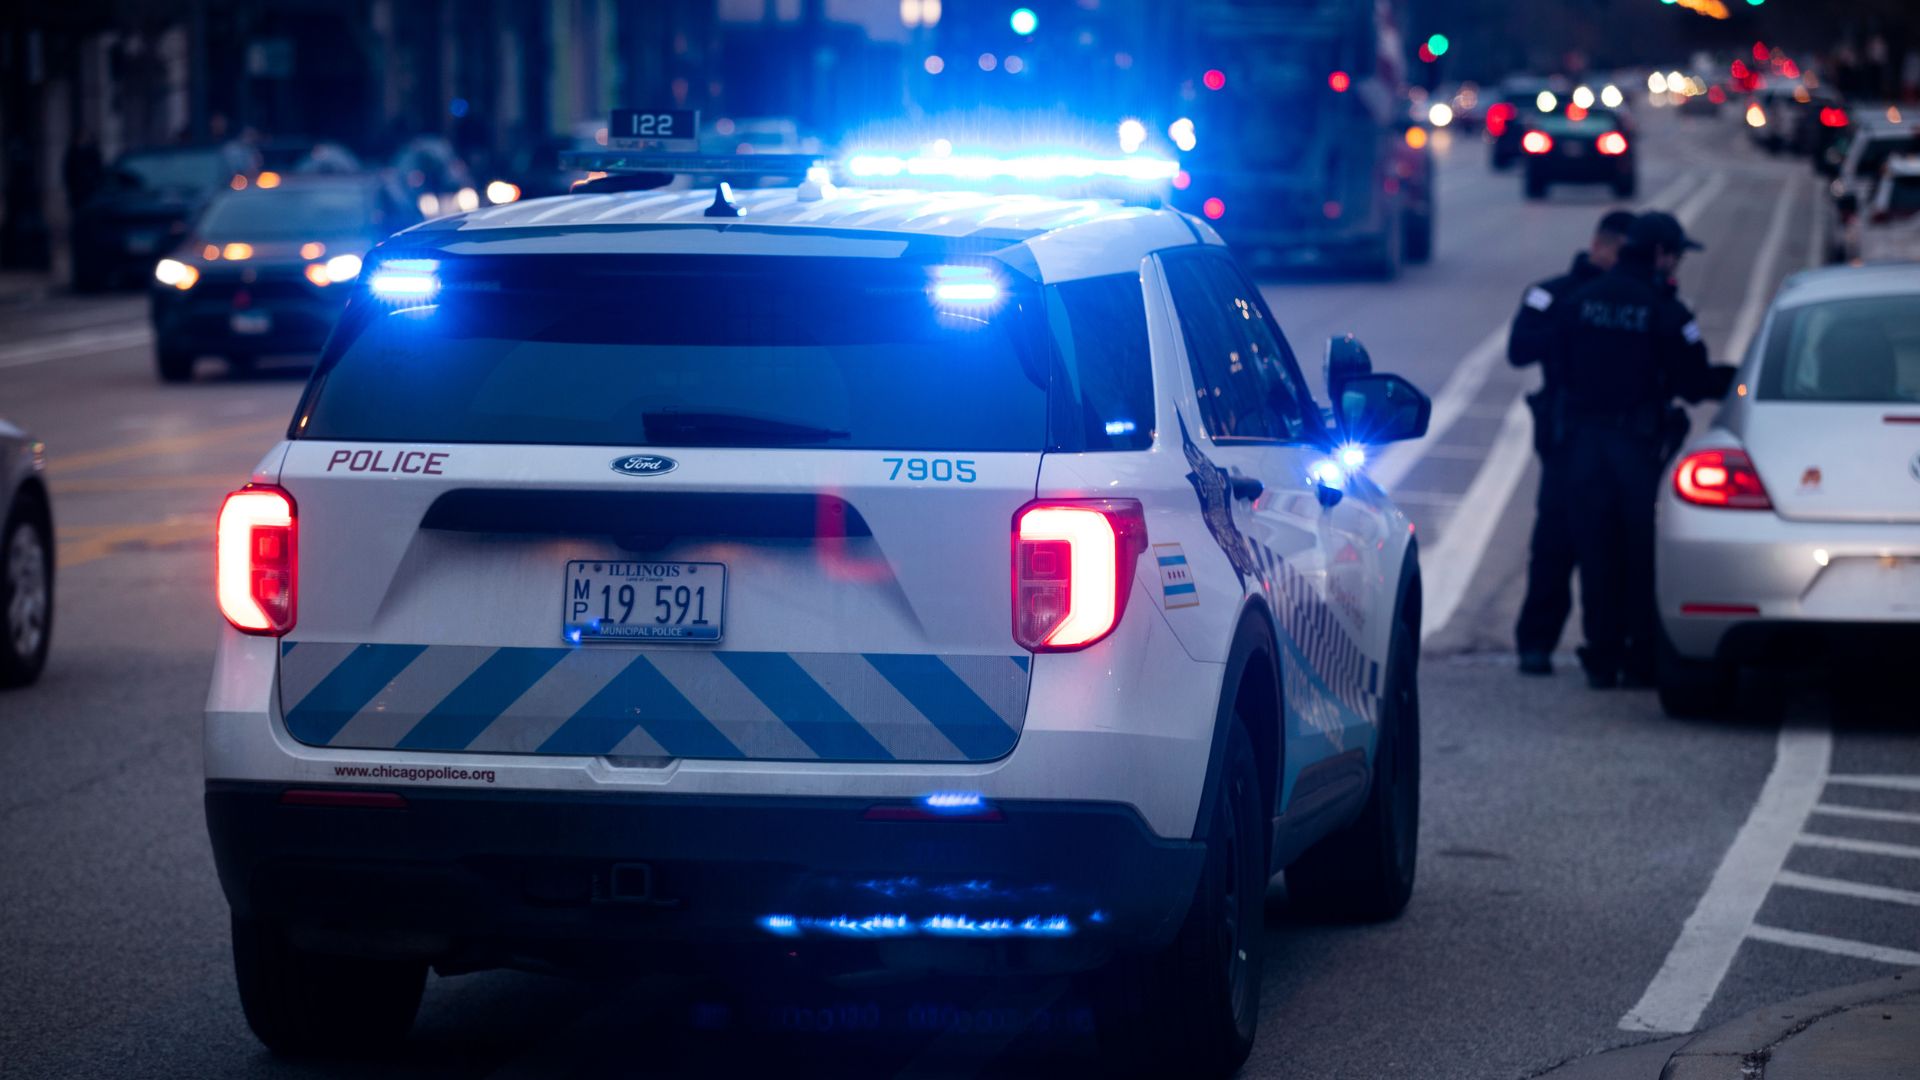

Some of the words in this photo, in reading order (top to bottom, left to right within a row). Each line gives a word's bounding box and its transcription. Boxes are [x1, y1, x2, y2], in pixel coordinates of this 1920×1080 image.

[632, 114, 673, 135] 122
[1581, 300, 1649, 333] POLICE
[326, 449, 450, 475] POLICE
[882, 457, 977, 483] 7905
[608, 564, 681, 577] ILLINOIS
[598, 584, 635, 624] 19
[655, 585, 708, 625] 591
[600, 626, 649, 636] MUNICIPAL
[651, 626, 683, 637] POLICE
[334, 765, 496, 783] www.chicagopolice.org
